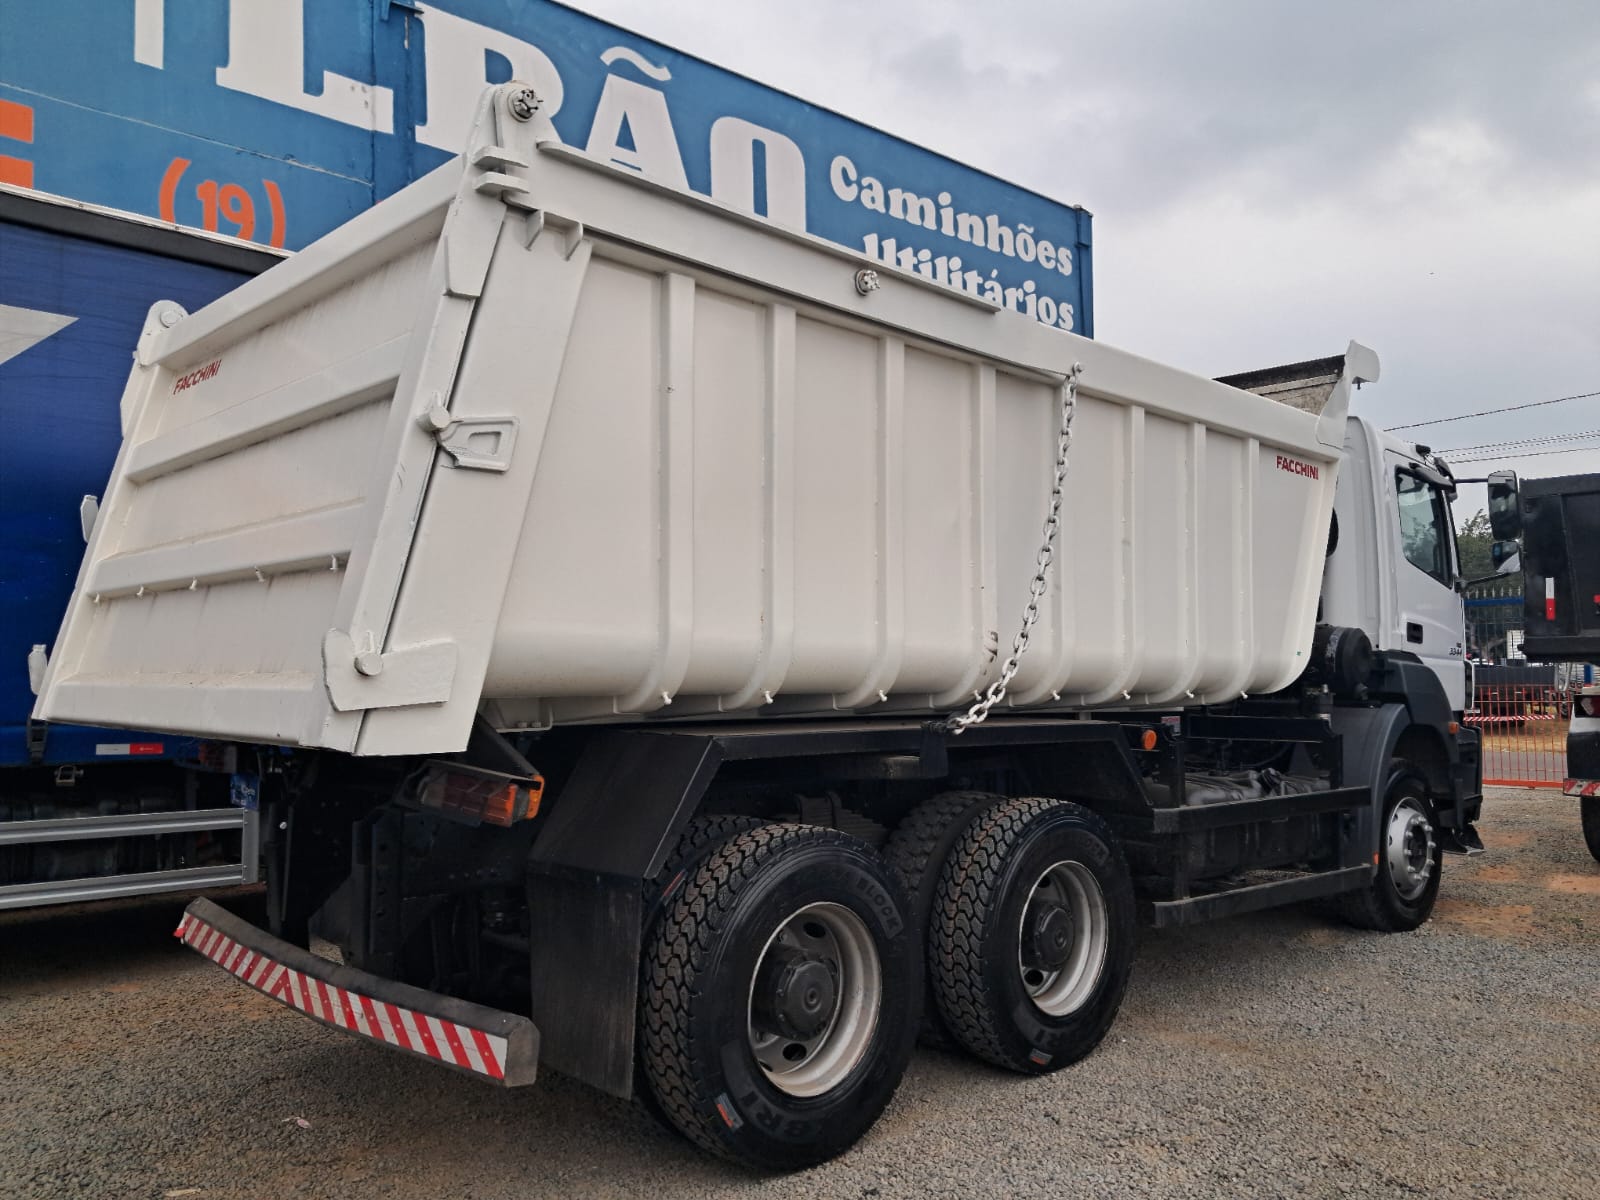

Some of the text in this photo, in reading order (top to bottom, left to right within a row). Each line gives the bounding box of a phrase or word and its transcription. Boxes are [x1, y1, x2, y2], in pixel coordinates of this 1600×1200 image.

[158, 157, 286, 249] (19)
[830, 155, 1073, 276] Caminhões
[173, 359, 222, 395] FACCHINI
[1276, 455, 1319, 480] FACCHINI
[856, 877, 900, 930] BLOCK
